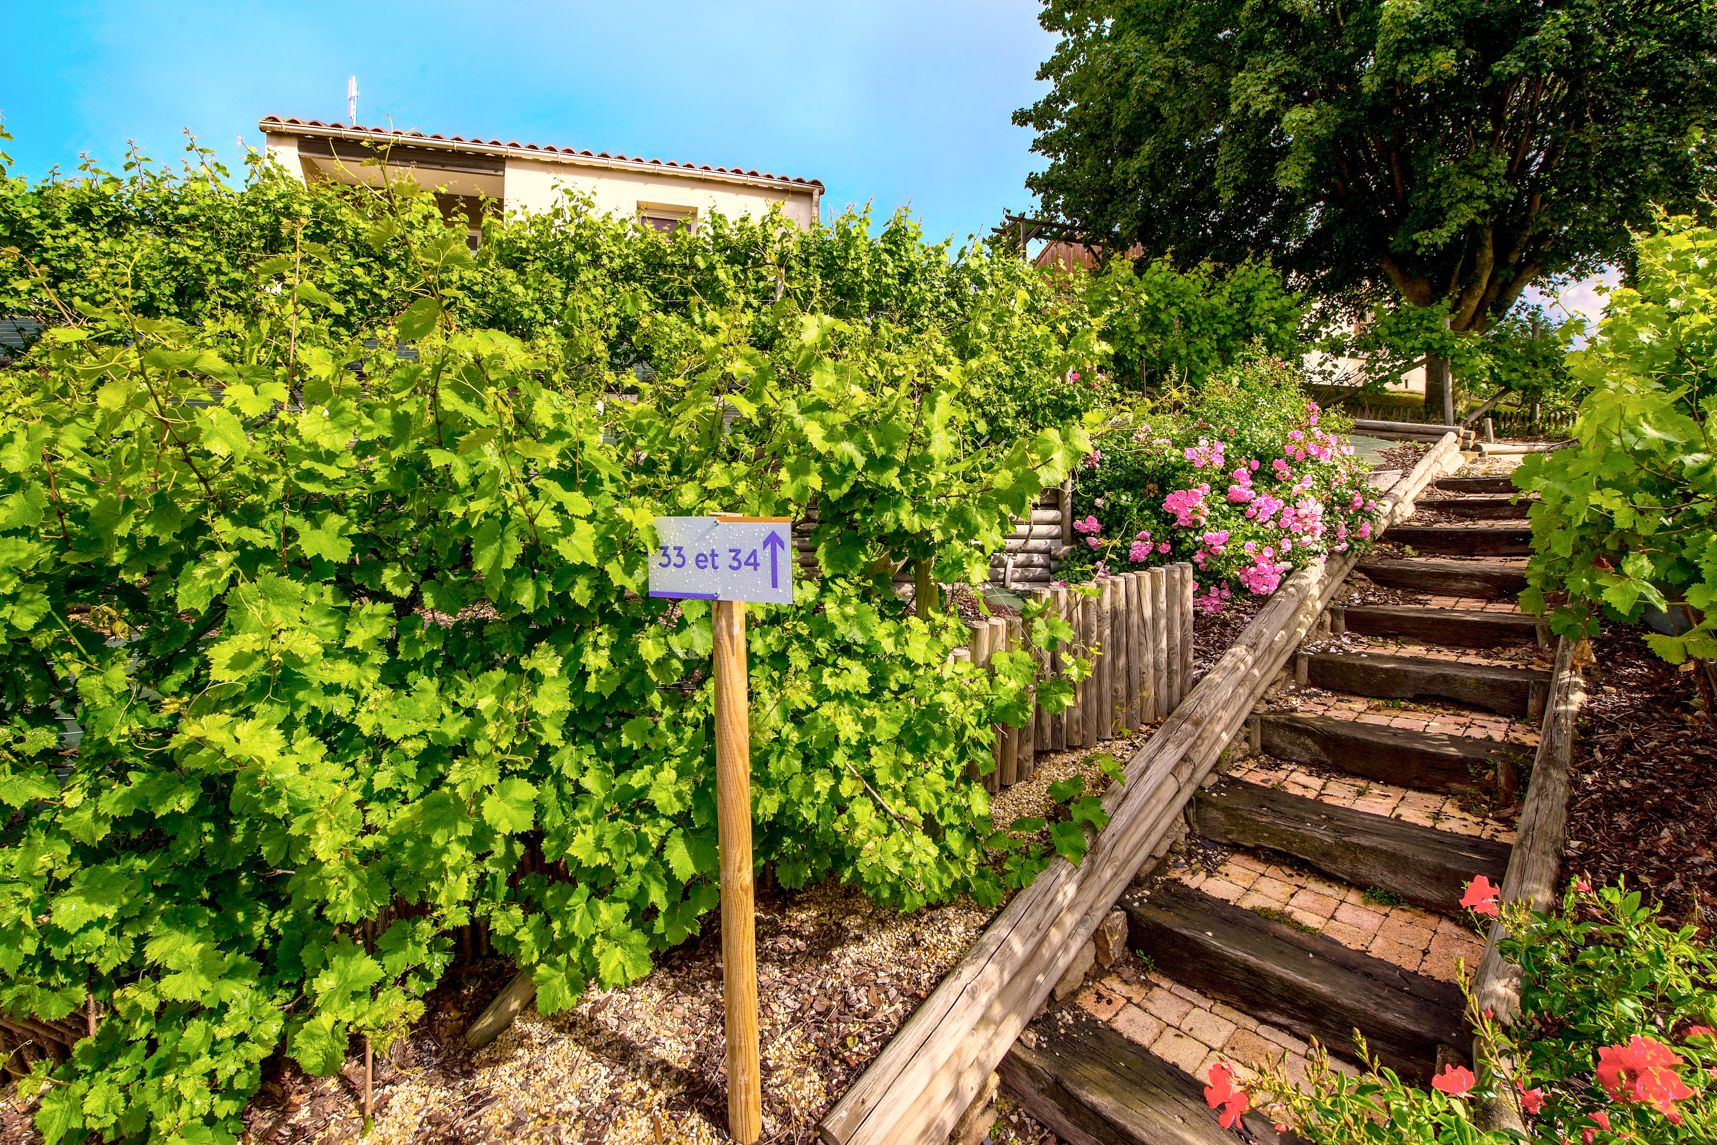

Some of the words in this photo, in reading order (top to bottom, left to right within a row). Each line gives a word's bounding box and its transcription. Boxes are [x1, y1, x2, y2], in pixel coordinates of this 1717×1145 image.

[658, 545, 686, 569] 33
[694, 548, 720, 570] et
[728, 548, 760, 571] 34
